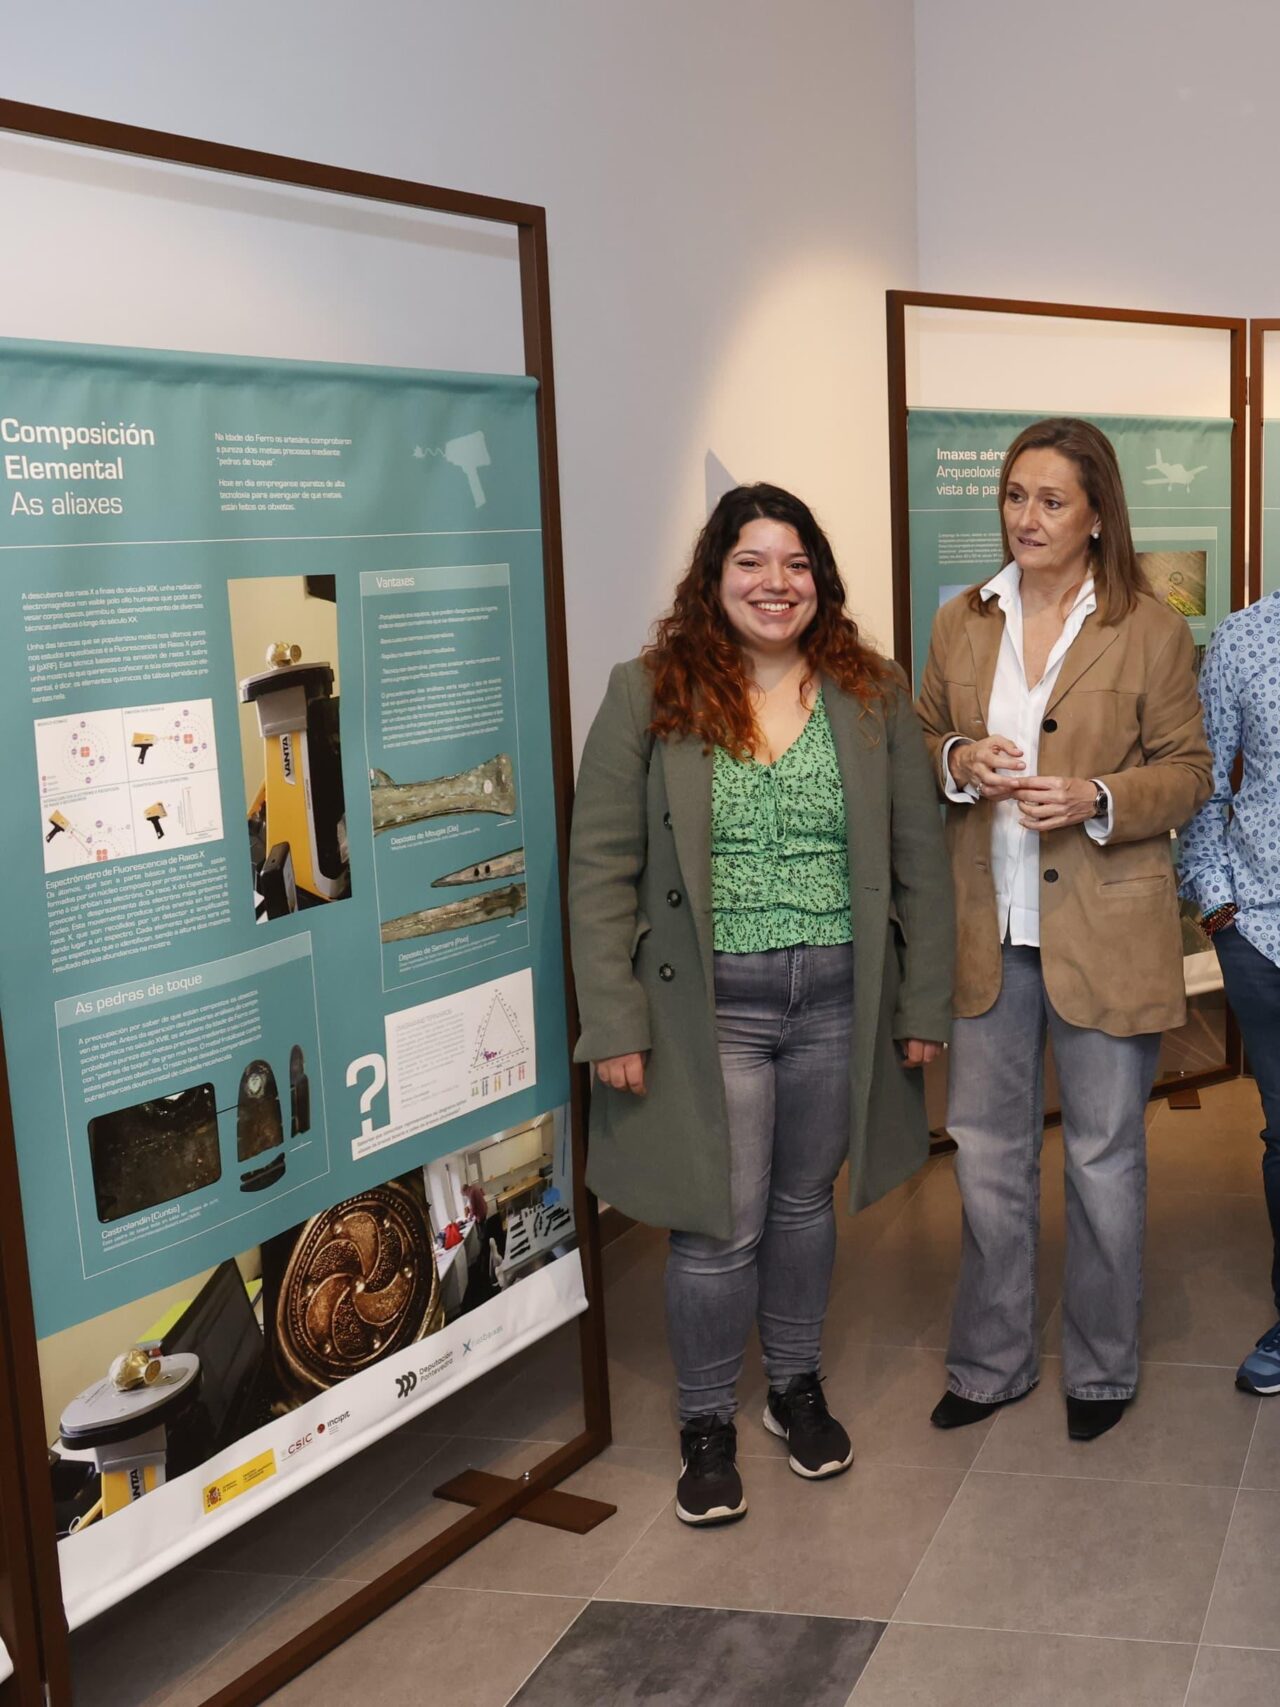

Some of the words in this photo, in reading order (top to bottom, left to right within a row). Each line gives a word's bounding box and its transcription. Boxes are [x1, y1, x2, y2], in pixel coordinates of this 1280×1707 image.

[1, 418, 155, 450] Composición
[937, 448, 977, 460] Imaxes
[980, 448, 1009, 460] aére
[5, 455, 124, 480] Elemental
[936, 482, 963, 495] vista
[966, 483, 979, 495] de
[11, 491, 44, 516] As
[52, 491, 123, 515] aliaxes
[376, 576, 415, 589] Vantaxes
[282, 736, 291, 777] VANTA
[113, 858, 167, 875] Fluorescencia
[75, 1000, 93, 1016] As
[97, 986, 144, 1010] pedras
[148, 982, 164, 998] de
[167, 974, 202, 993] toque
[327, 1411, 350, 1427] incipit
[288, 1433, 312, 1455] CSIC
